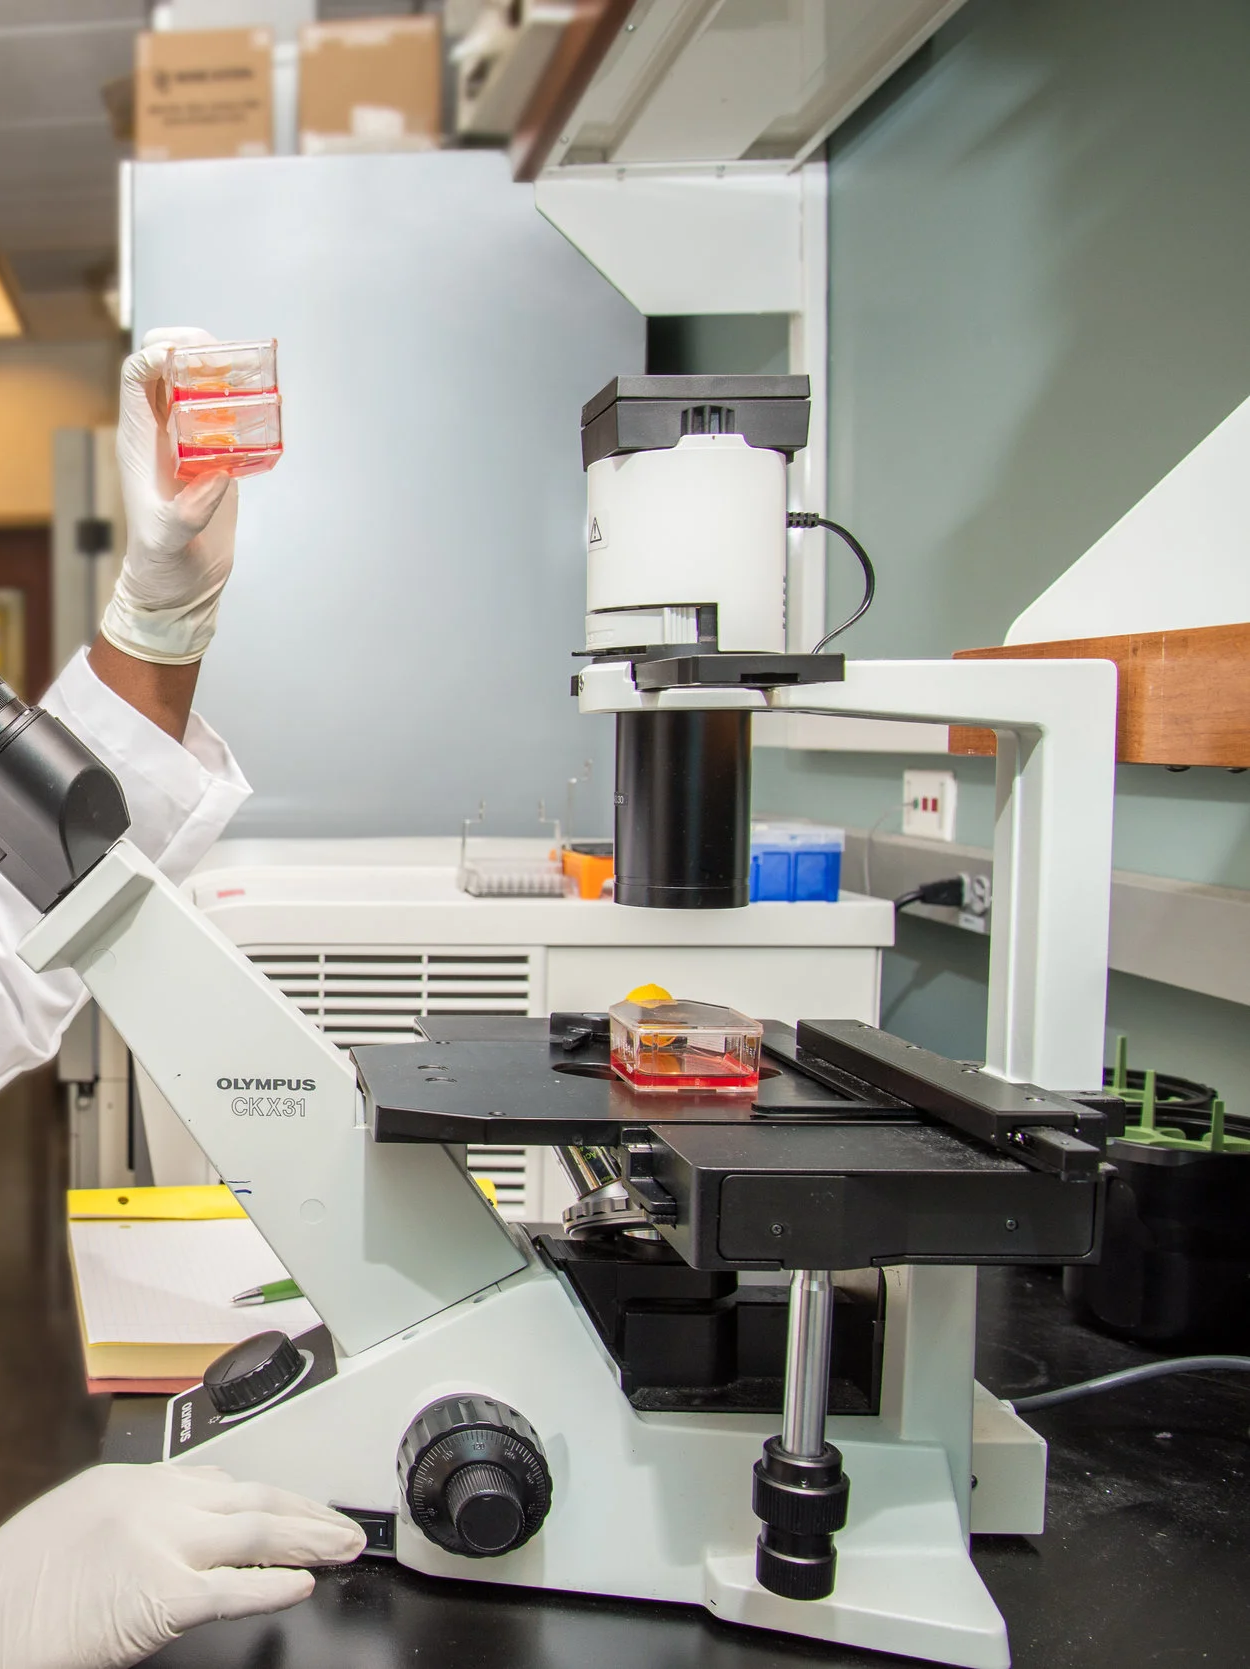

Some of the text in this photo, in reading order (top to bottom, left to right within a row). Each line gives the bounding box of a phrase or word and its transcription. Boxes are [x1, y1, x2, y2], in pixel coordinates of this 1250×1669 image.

[216, 1077, 317, 1092] OLYMPUS
[231, 1096, 306, 1118] CKX31
[180, 1401, 193, 1443] OLYMPUS
